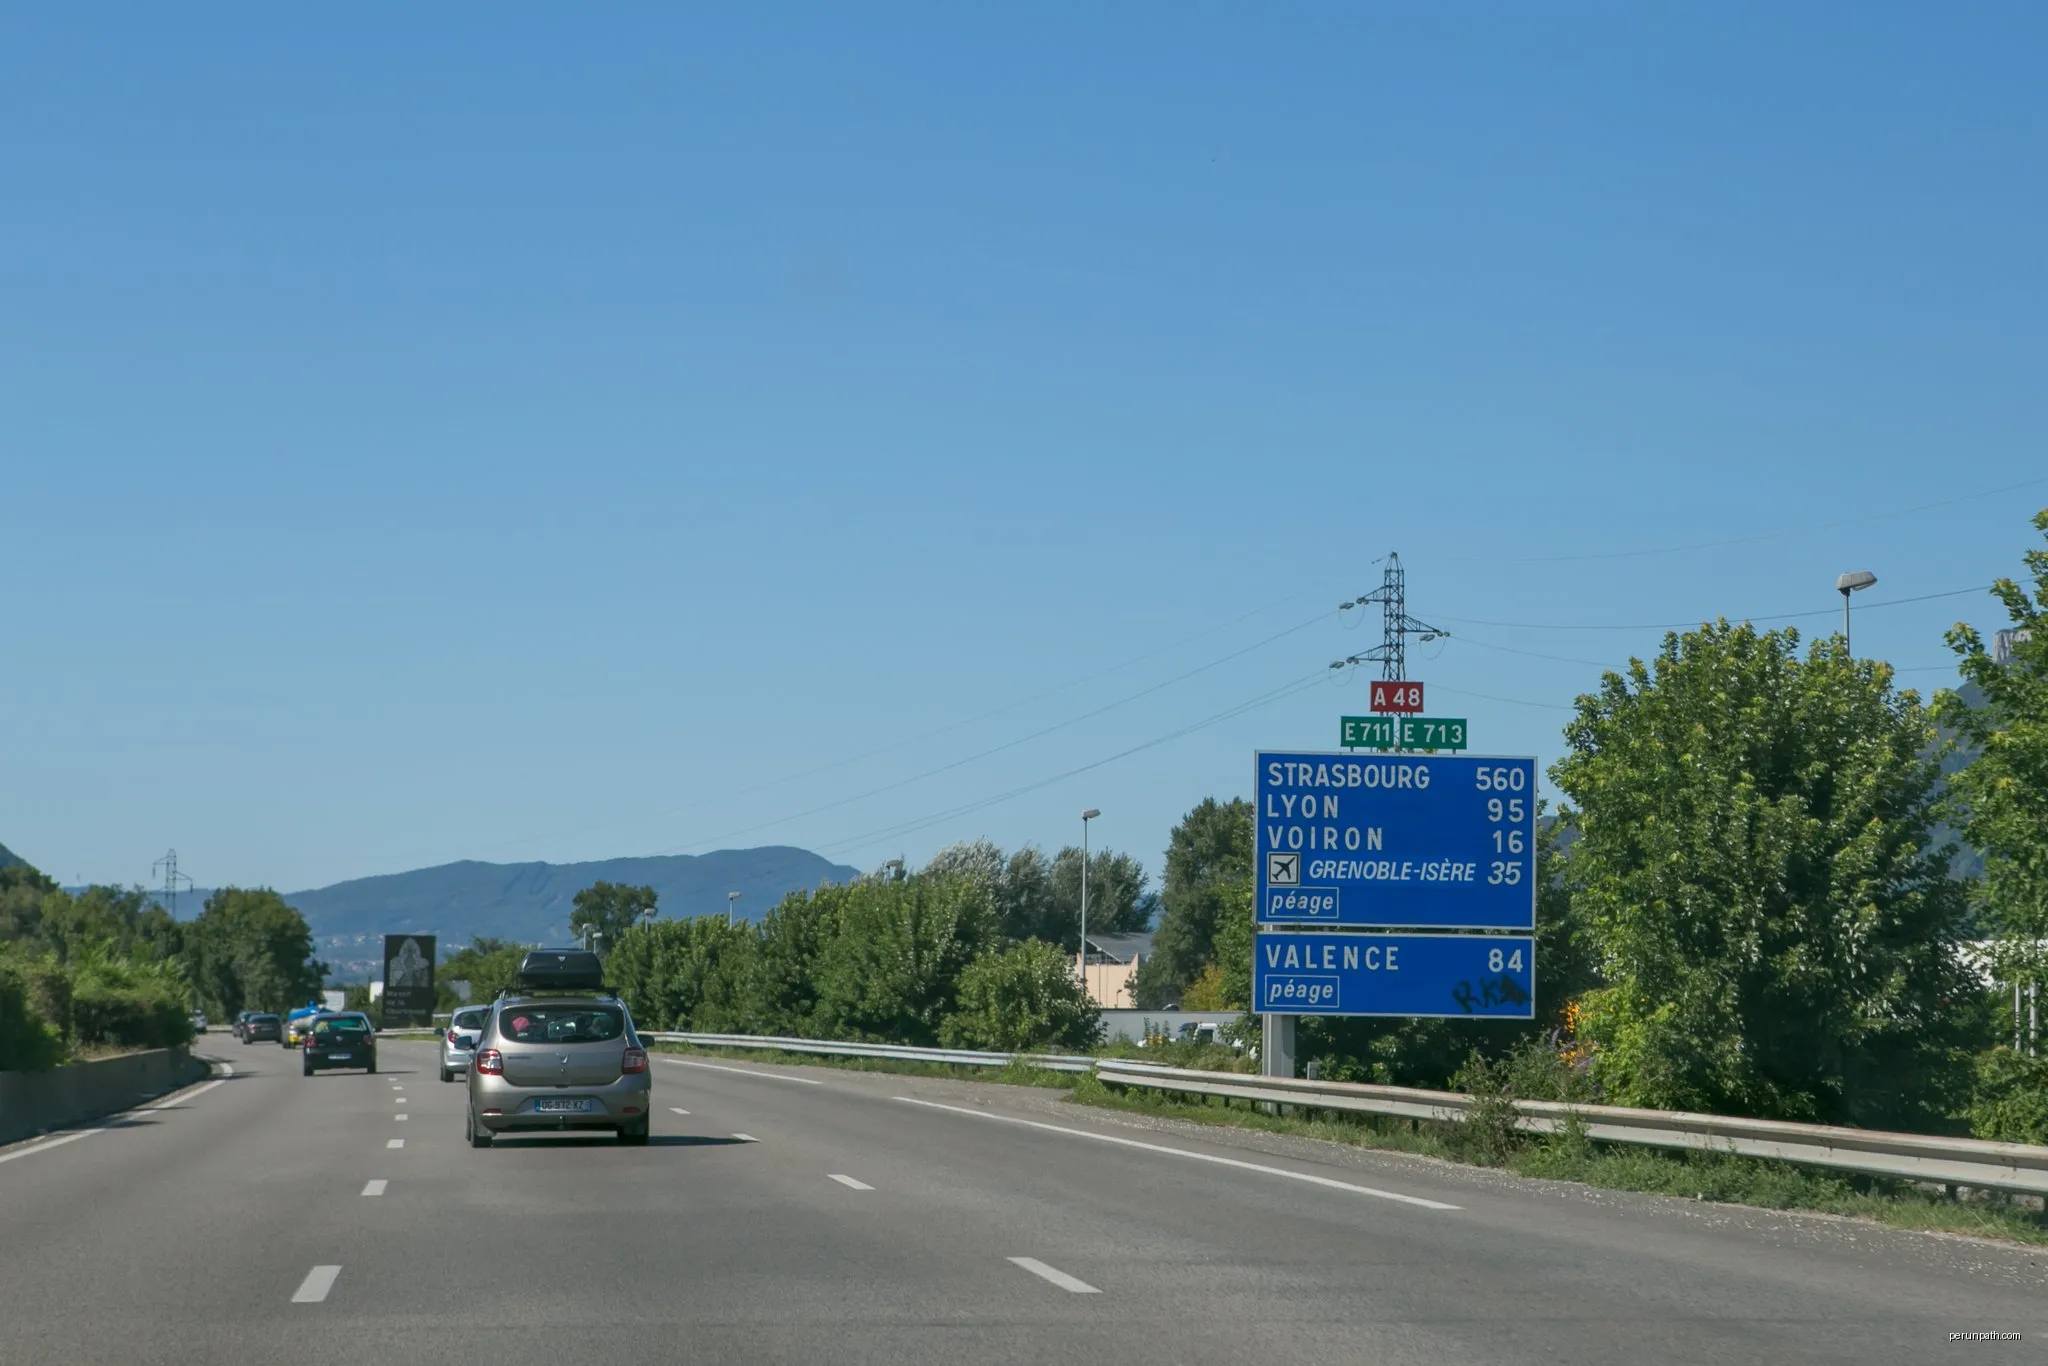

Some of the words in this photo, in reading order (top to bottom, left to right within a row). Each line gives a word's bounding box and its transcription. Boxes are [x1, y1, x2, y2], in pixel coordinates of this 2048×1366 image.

[1373, 687, 1386, 707] A
[1393, 687, 1420, 707] 48
[1345, 722, 1356, 741] E
[1360, 722, 1390, 742] 711
[1404, 723, 1415, 742] E
[1424, 724, 1463, 744] 713
[1268, 762, 1430, 789] STRASBOURG
[1475, 766, 1525, 791] 560
[1267, 794, 1339, 819] LYON
[1487, 798, 1525, 823] 95
[1267, 825, 1383, 851] VOIRON
[1492, 829, 1524, 854] 16
[1309, 857, 1476, 882] GRENOBLE-ISÈRE
[1487, 861, 1522, 885] 35
[1271, 890, 1334, 914] péage
[1265, 944, 1399, 970] VALENCE
[1488, 948, 1524, 973] 84
[1270, 979, 1333, 1002] péage
